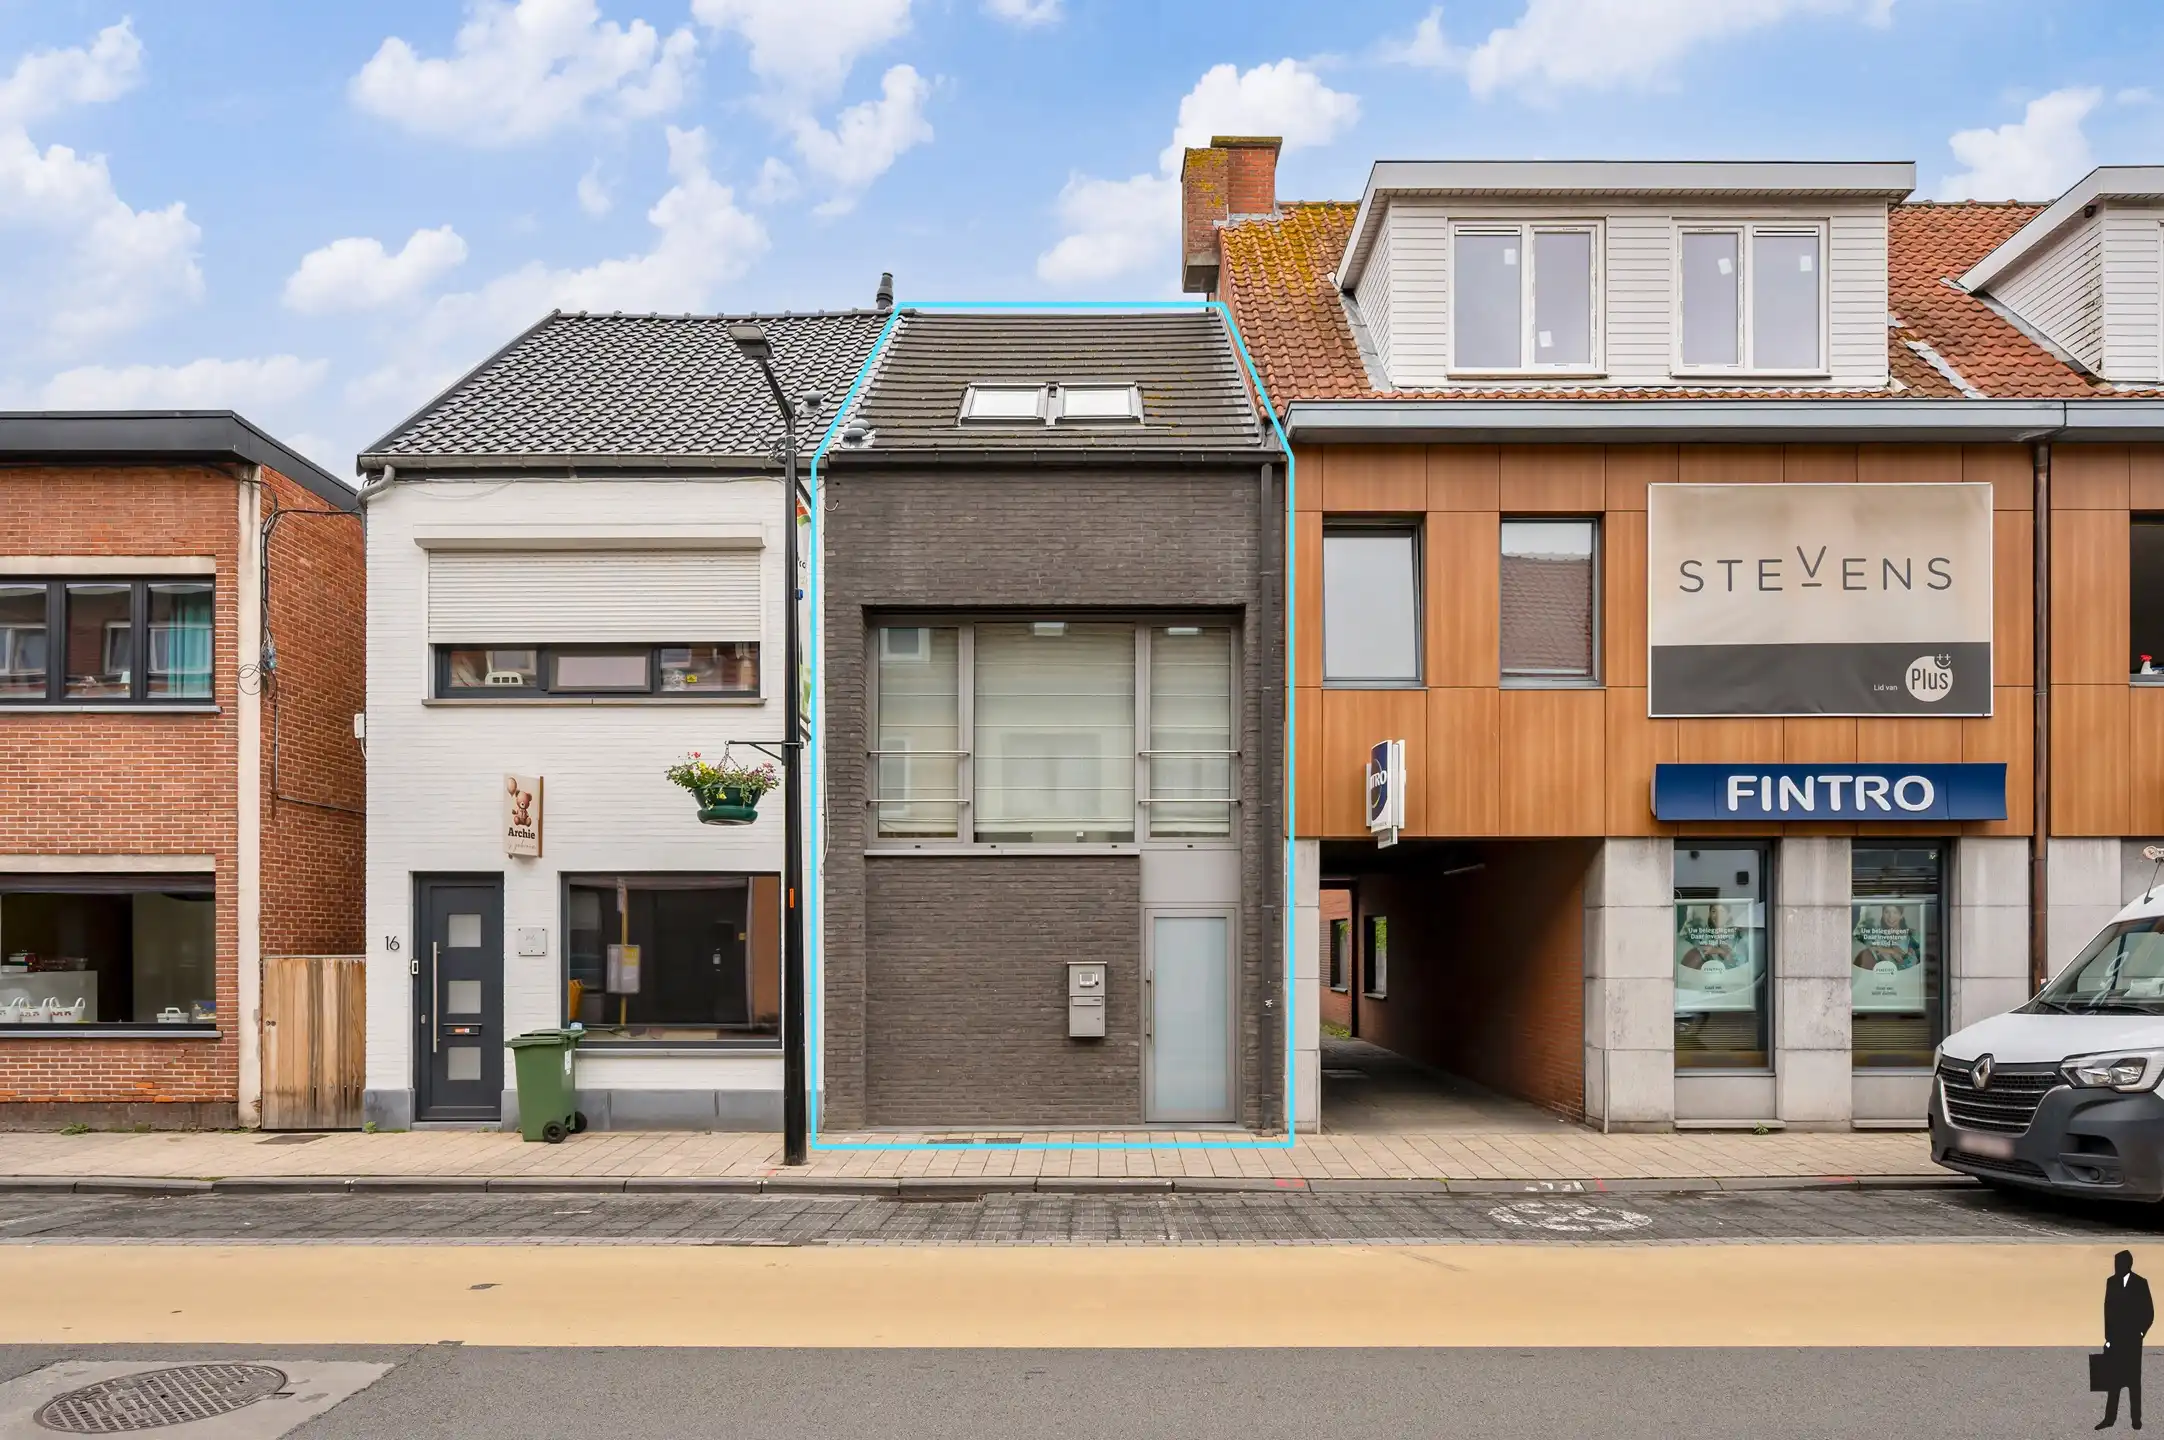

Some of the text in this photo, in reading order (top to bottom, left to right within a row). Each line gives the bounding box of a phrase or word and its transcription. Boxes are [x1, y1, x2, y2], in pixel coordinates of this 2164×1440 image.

[1679, 545, 1953, 593] STEVENS
[1911, 668, 1949, 690] Plus
[1726, 774, 1935, 812] FINTRO
[507, 827, 536, 839] Archie
[385, 936, 400, 951] 16
